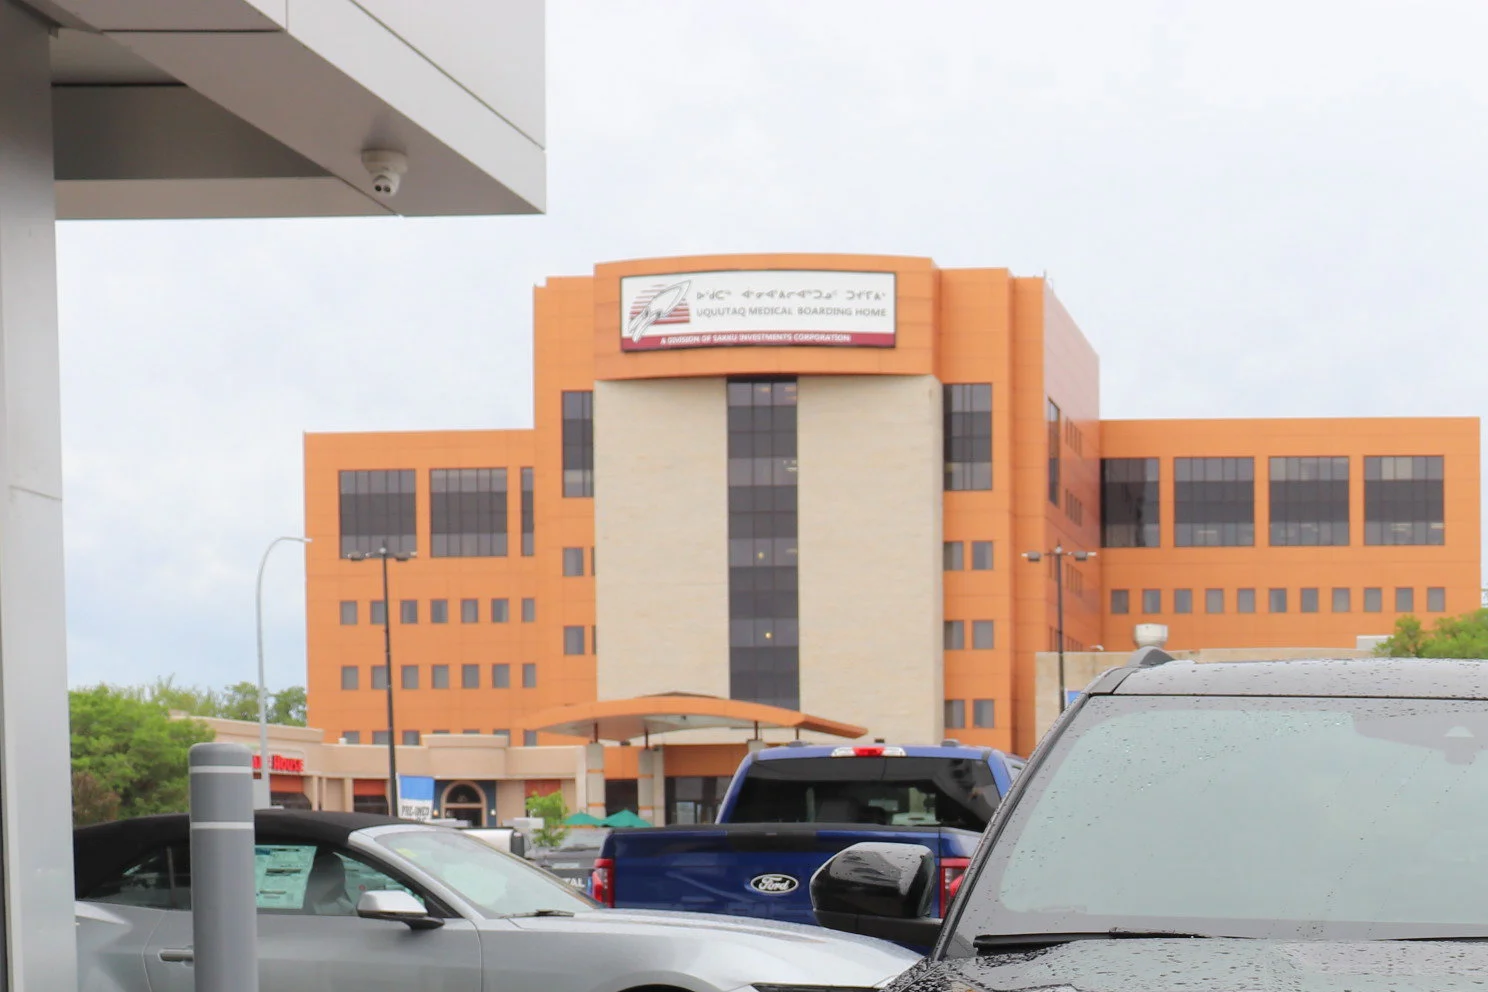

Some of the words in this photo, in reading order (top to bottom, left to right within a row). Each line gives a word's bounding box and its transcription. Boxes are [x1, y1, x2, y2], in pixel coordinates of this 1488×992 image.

[696, 306, 746, 318] UQUUTAQ
[748, 306, 793, 316] MEDICAL
[797, 306, 852, 317] BOARDING
[854, 307, 887, 318] HOME
[738, 333, 792, 342] INVESTMENTS
[793, 333, 851, 343] CORPORATION
[758, 876, 791, 891] Ford
